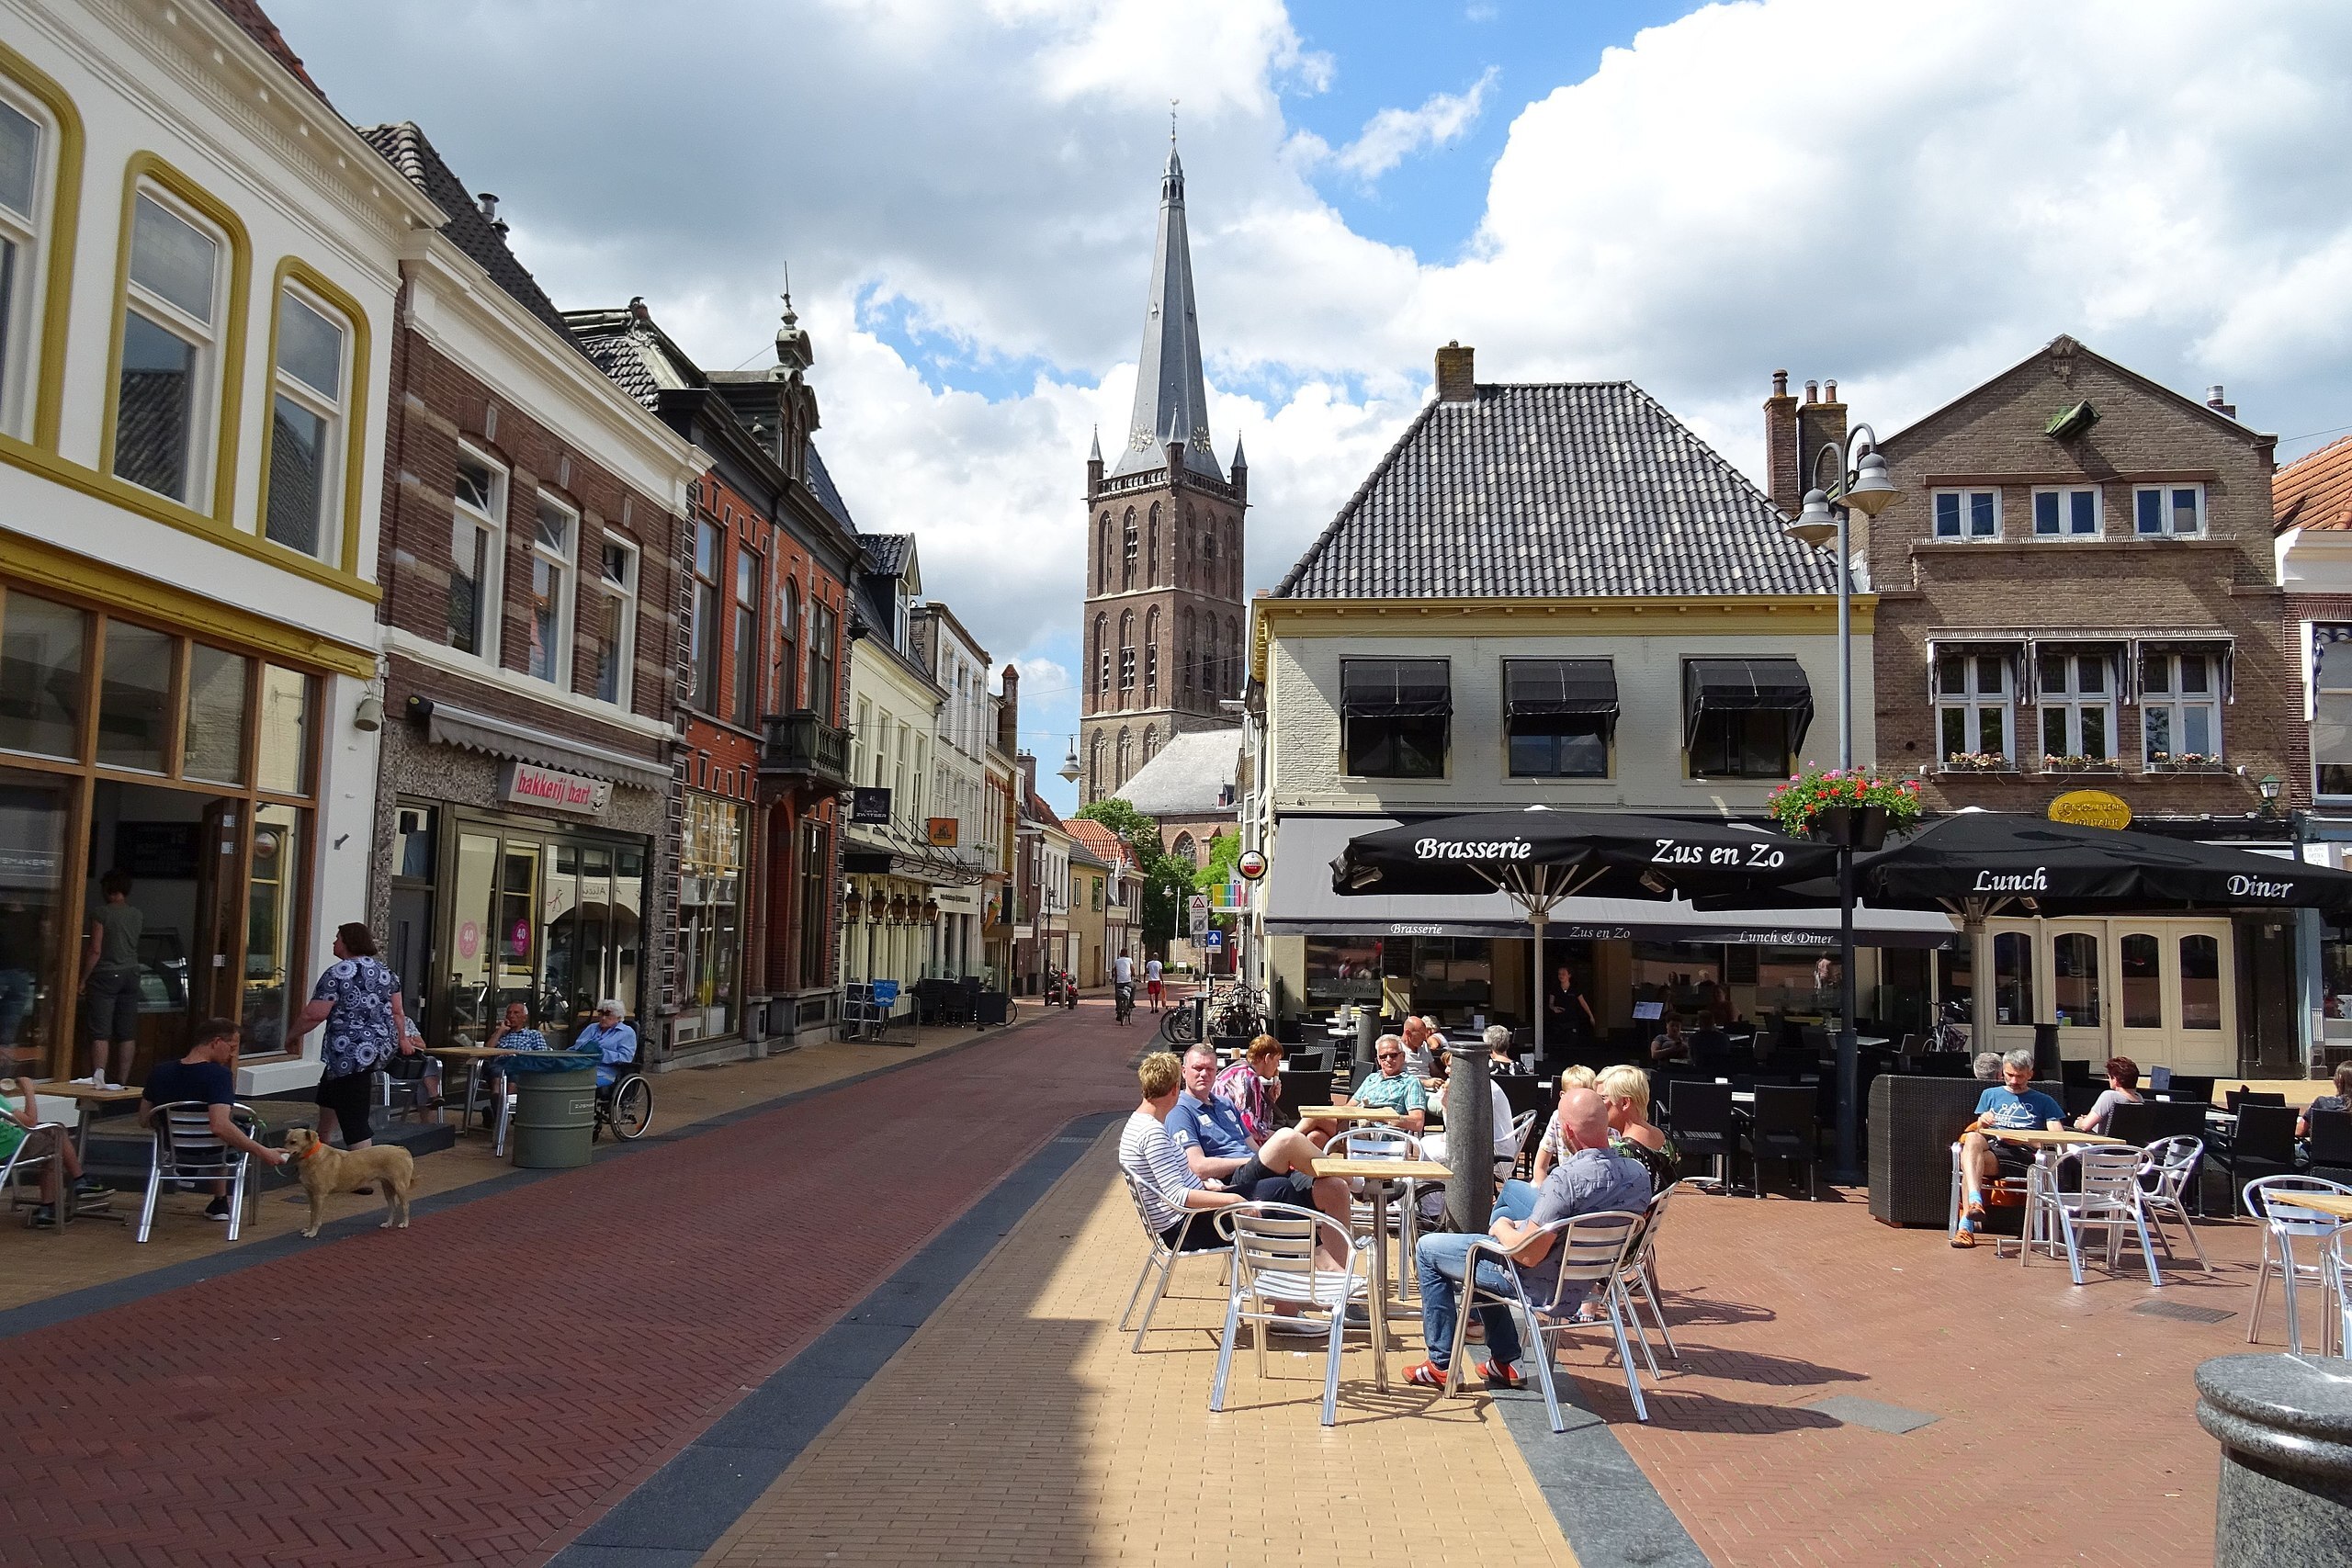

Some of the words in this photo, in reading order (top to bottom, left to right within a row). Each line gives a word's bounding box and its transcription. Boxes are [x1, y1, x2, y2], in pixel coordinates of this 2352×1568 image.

[516, 769, 566, 806] bakkerij
[567, 780, 591, 805] bart
[1415, 836, 1532, 859] Brasserie
[1651, 839, 1703, 863] Zus
[1710, 847, 1739, 865] en
[1746, 843, 1784, 868] Zo
[1973, 866, 2048, 891] Lunch
[2227, 874, 2294, 898] Diner
[463, 929, 474, 942] 40
[516, 928, 526, 940] 40
[1390, 923, 1442, 934] Brasserie
[1569, 926, 1594, 938] Zus
[1596, 929, 1610, 939] en
[1612, 927, 1631, 939] Zo
[1739, 931, 1778, 942] Lunch
[1781, 931, 1794, 943] &
[1797, 931, 1834, 944] Diner
